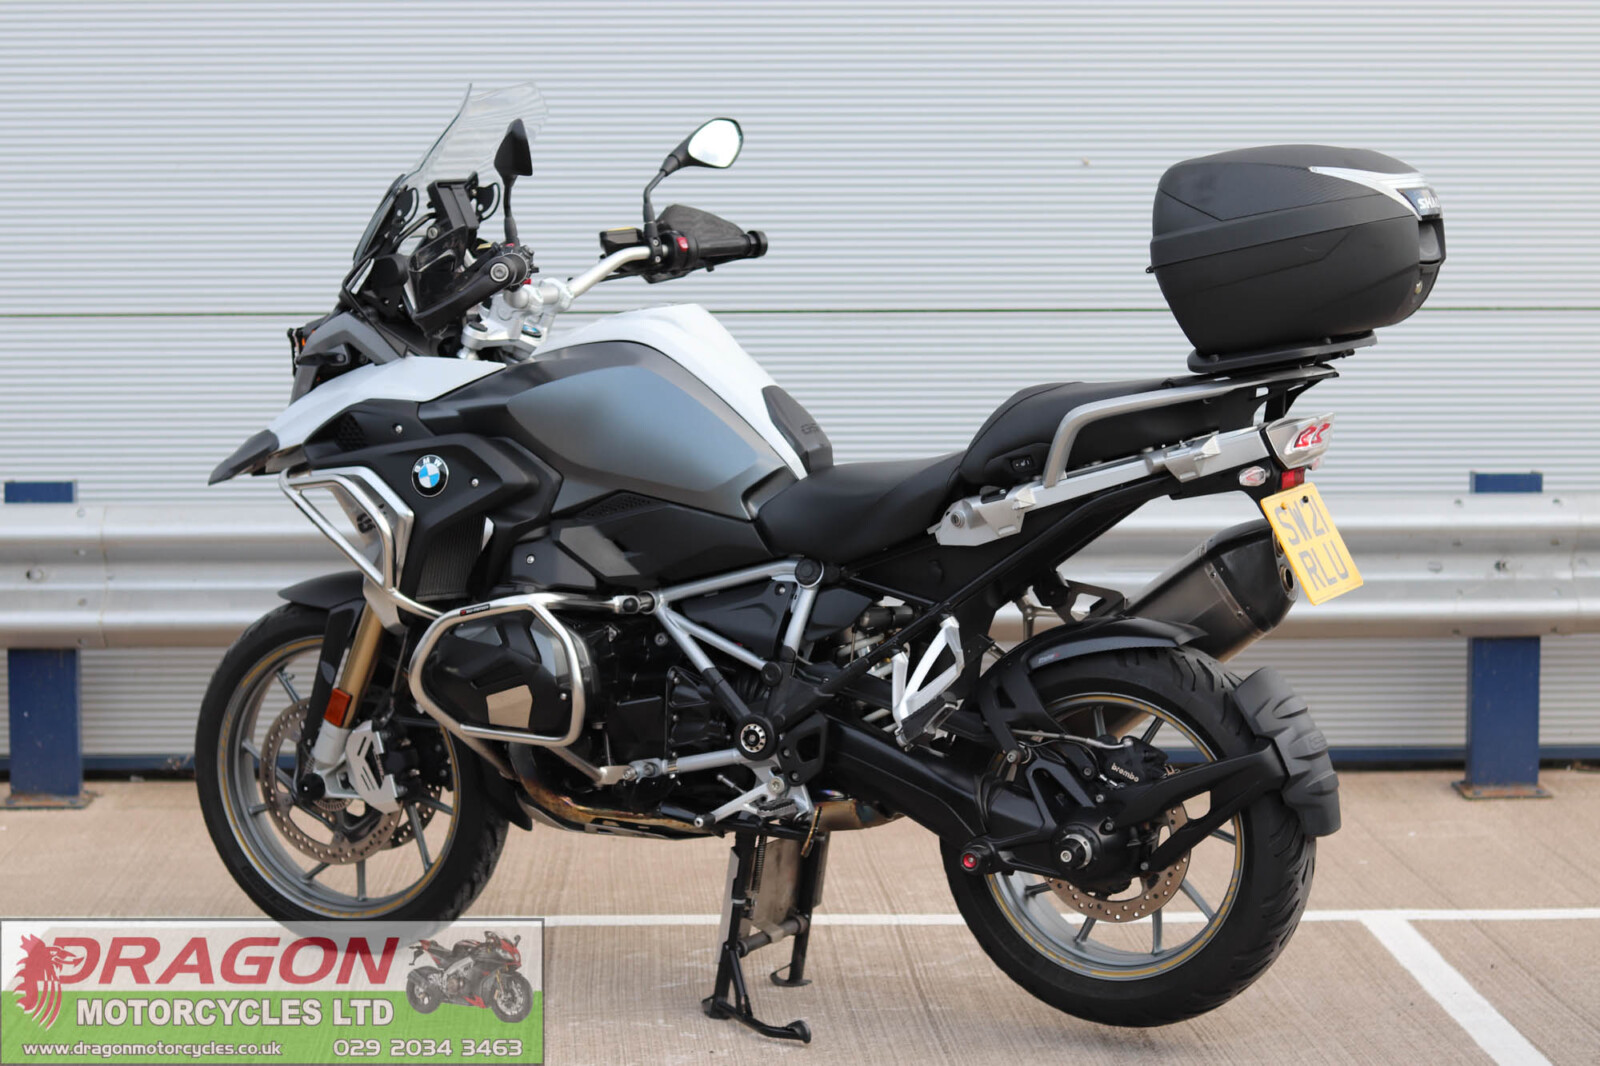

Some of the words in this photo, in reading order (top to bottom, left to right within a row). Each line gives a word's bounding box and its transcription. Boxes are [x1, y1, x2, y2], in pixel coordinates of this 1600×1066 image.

[414, 456, 442, 473] BMW
[1274, 495, 1330, 546] SW21
[1298, 540, 1350, 591] RLU
[1111, 762, 1139, 782] brembo
